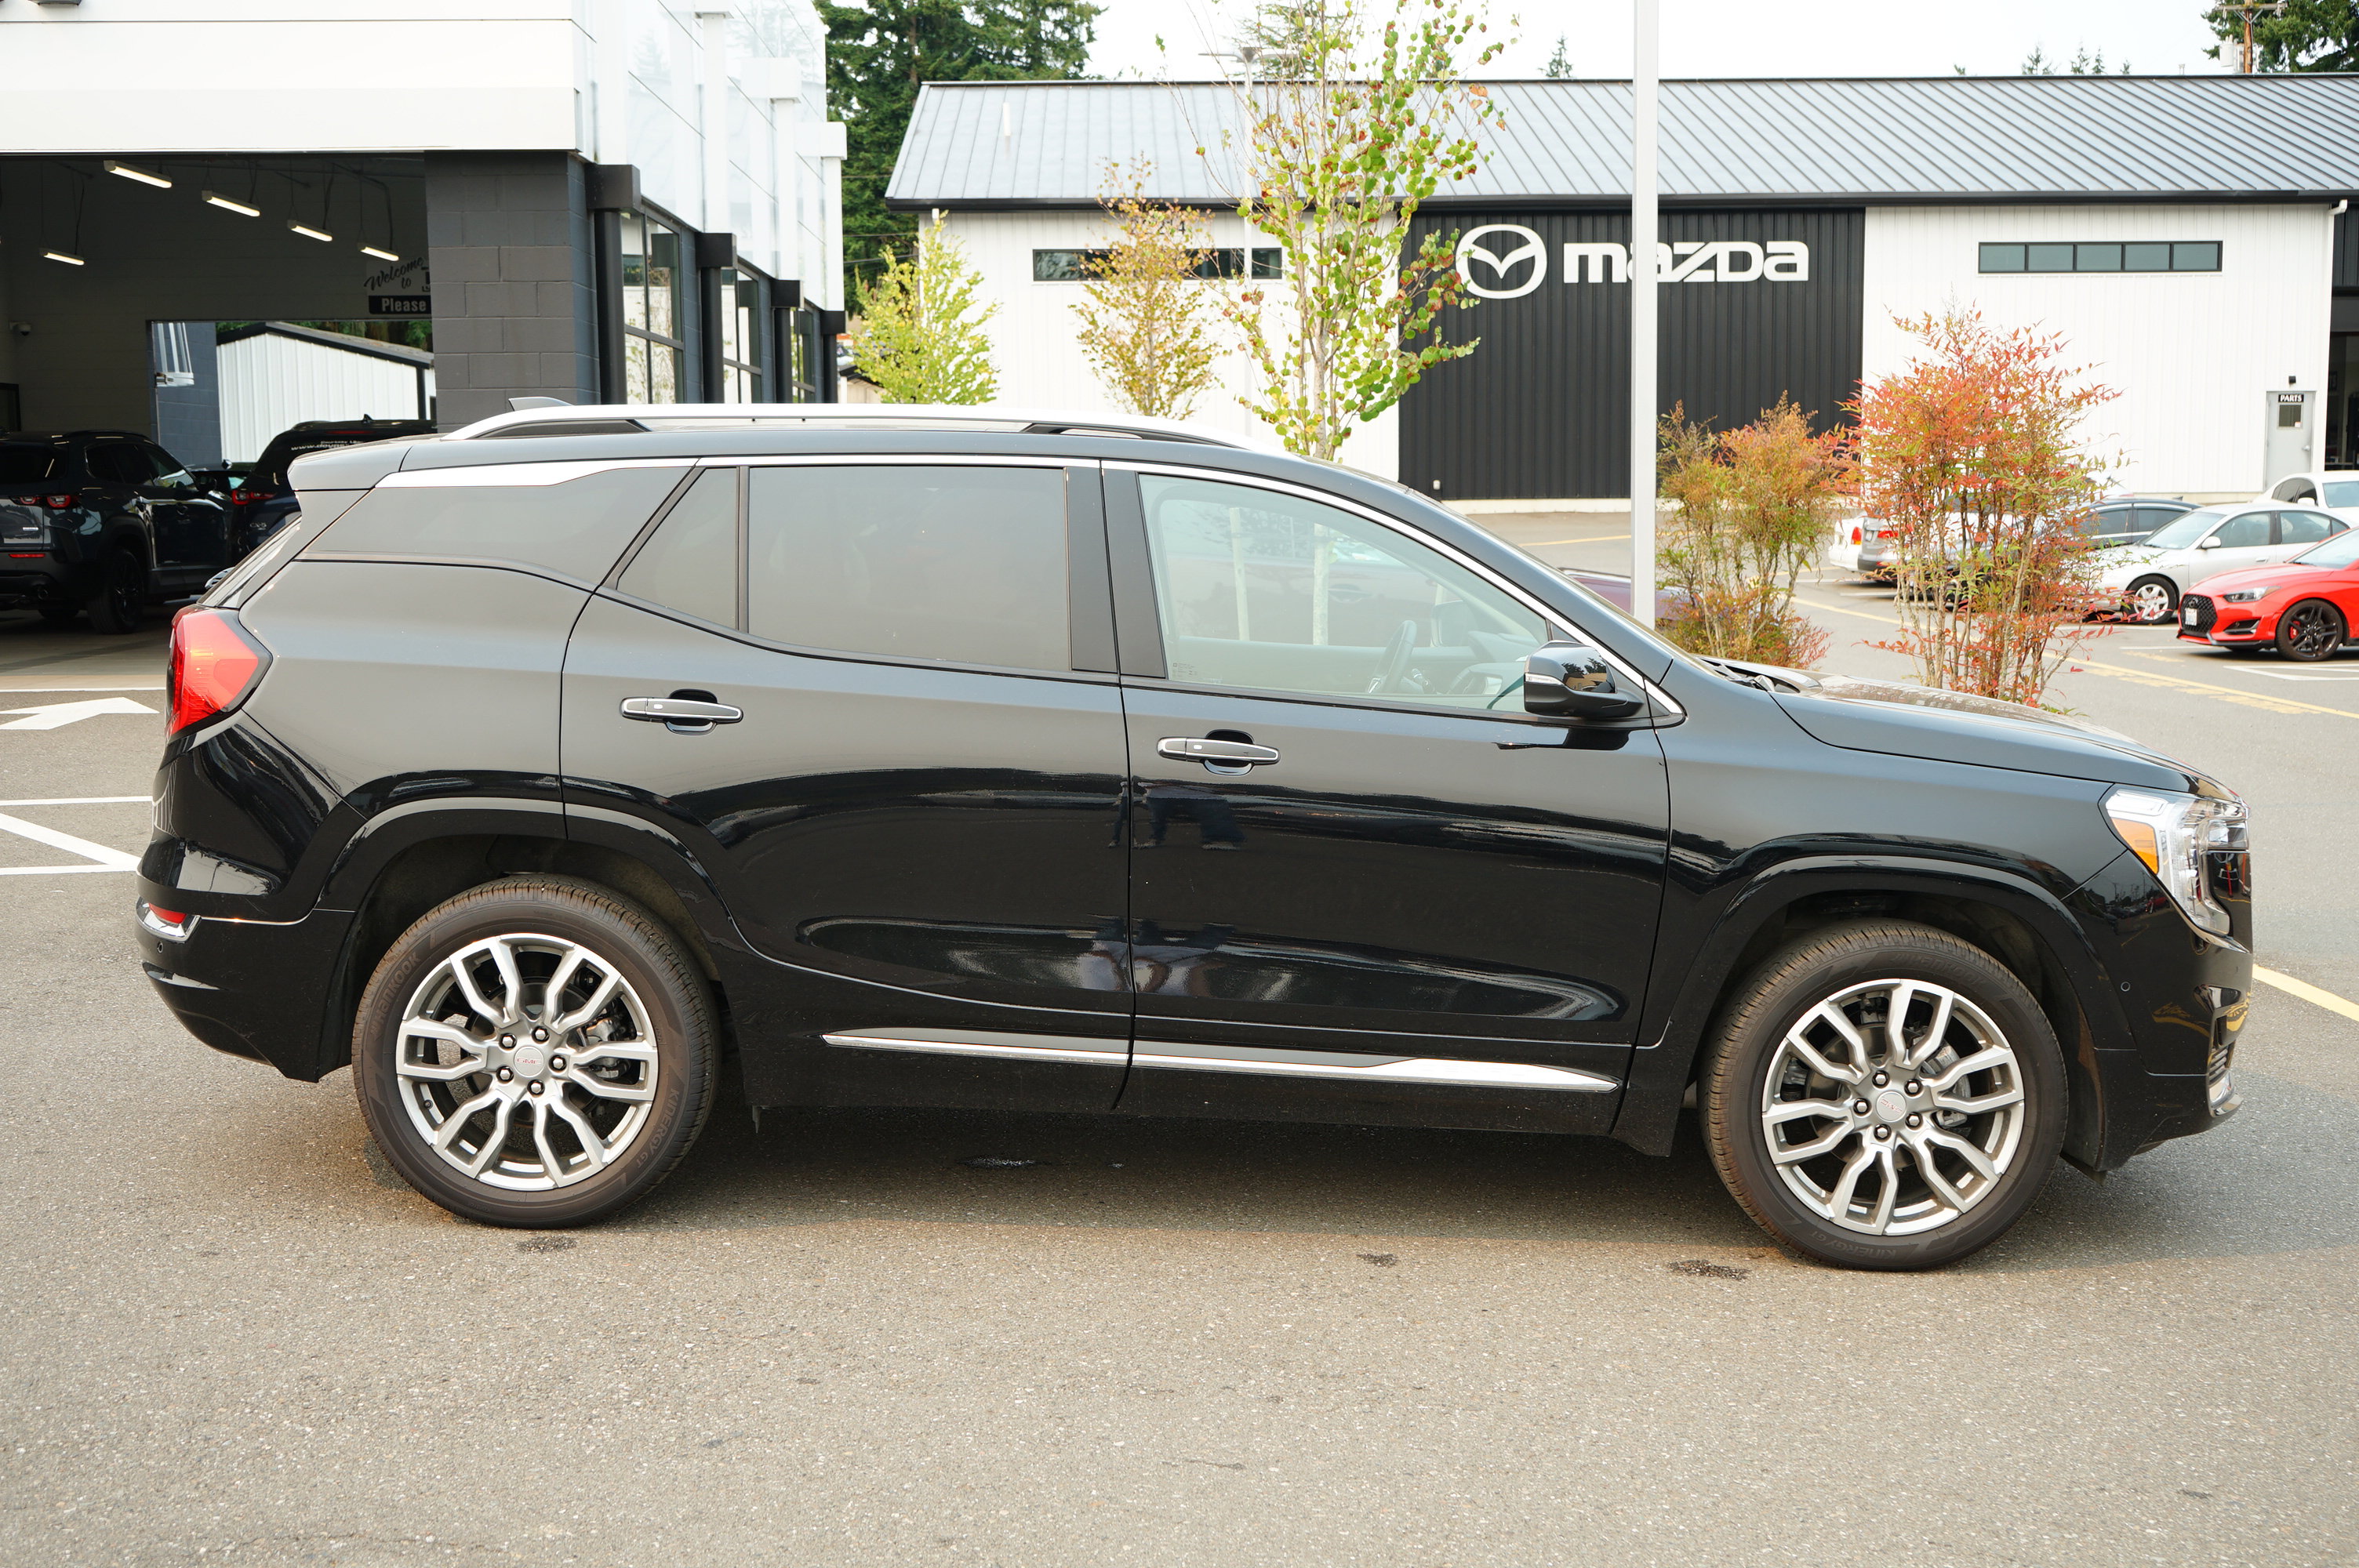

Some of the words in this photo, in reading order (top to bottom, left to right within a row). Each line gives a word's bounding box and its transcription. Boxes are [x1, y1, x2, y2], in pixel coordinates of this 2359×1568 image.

[364, 257, 424, 291] Welcome
[402, 277, 412, 289] to
[381, 298, 427, 312] Please
[515, 1056, 542, 1065] GMC
